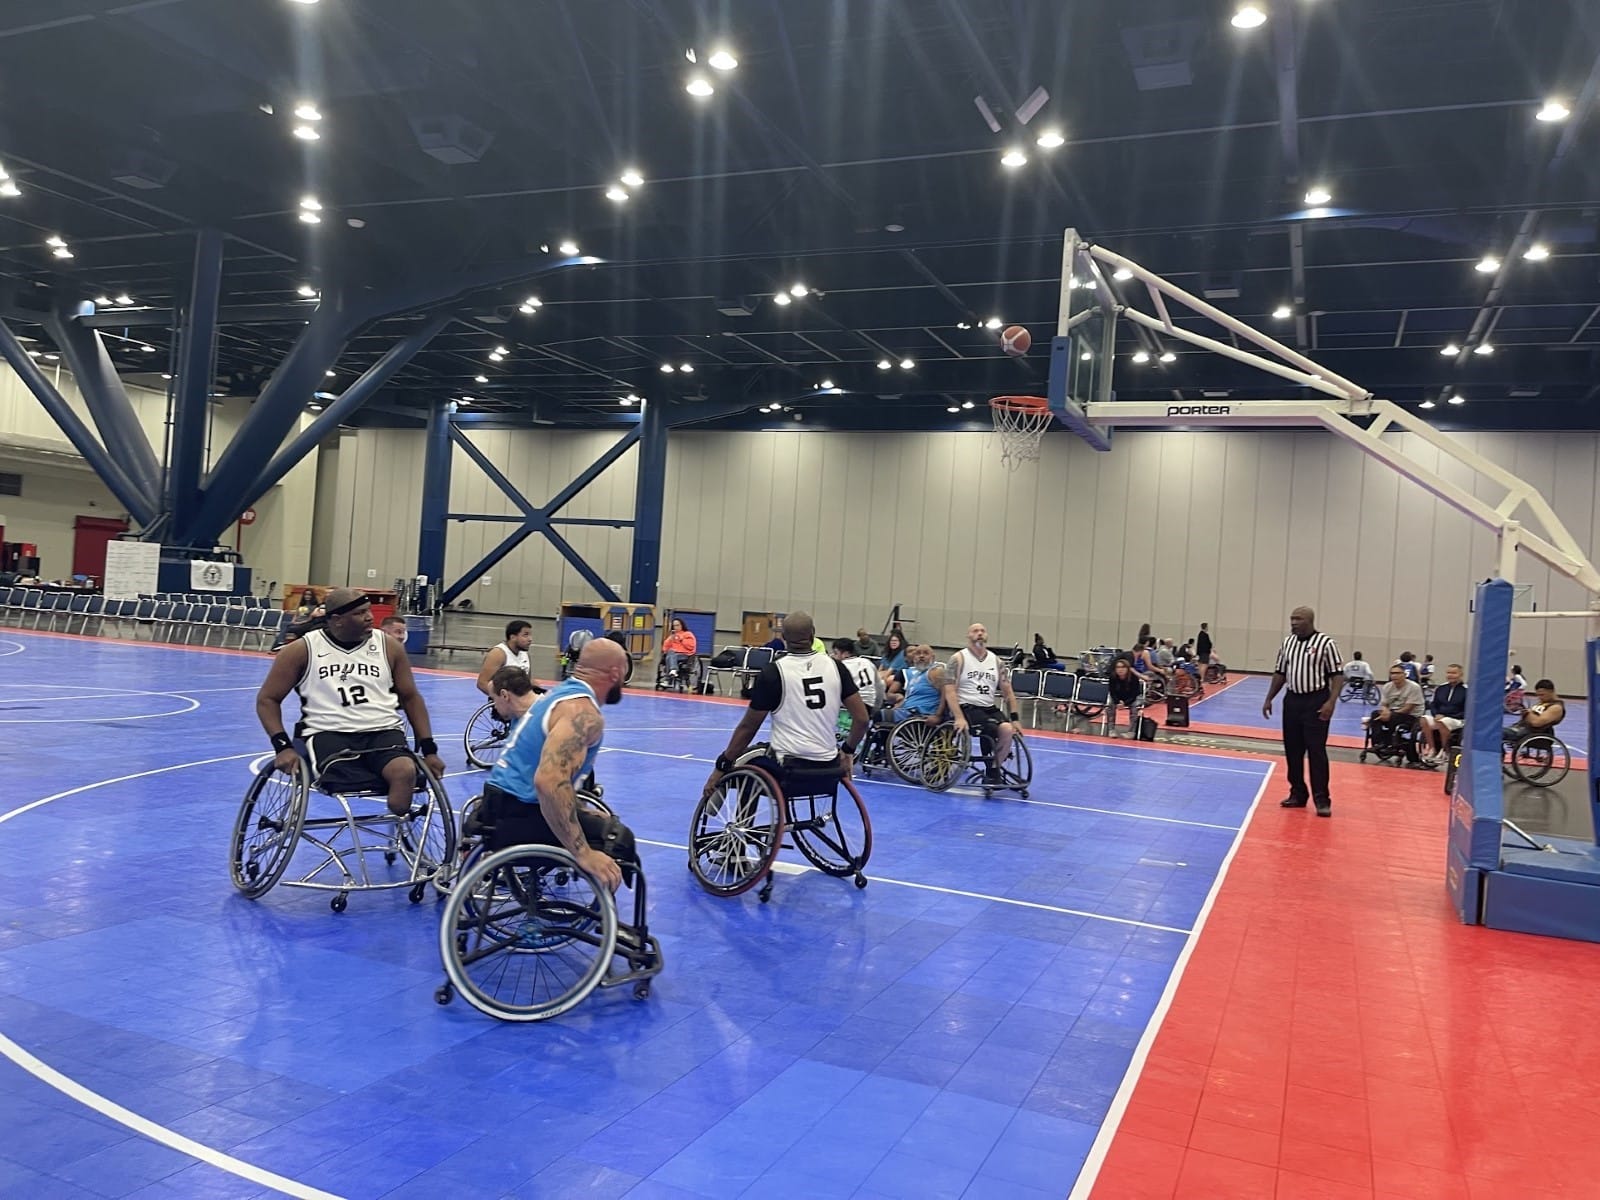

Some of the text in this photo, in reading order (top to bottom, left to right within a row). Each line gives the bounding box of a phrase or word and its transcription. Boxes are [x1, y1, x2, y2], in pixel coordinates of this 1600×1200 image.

[318, 663, 380, 681] SPURS
[858, 668, 872, 688] 11
[337, 685, 369, 707] 12
[802, 676, 826, 710] 5
[976, 685, 990, 695] 42
